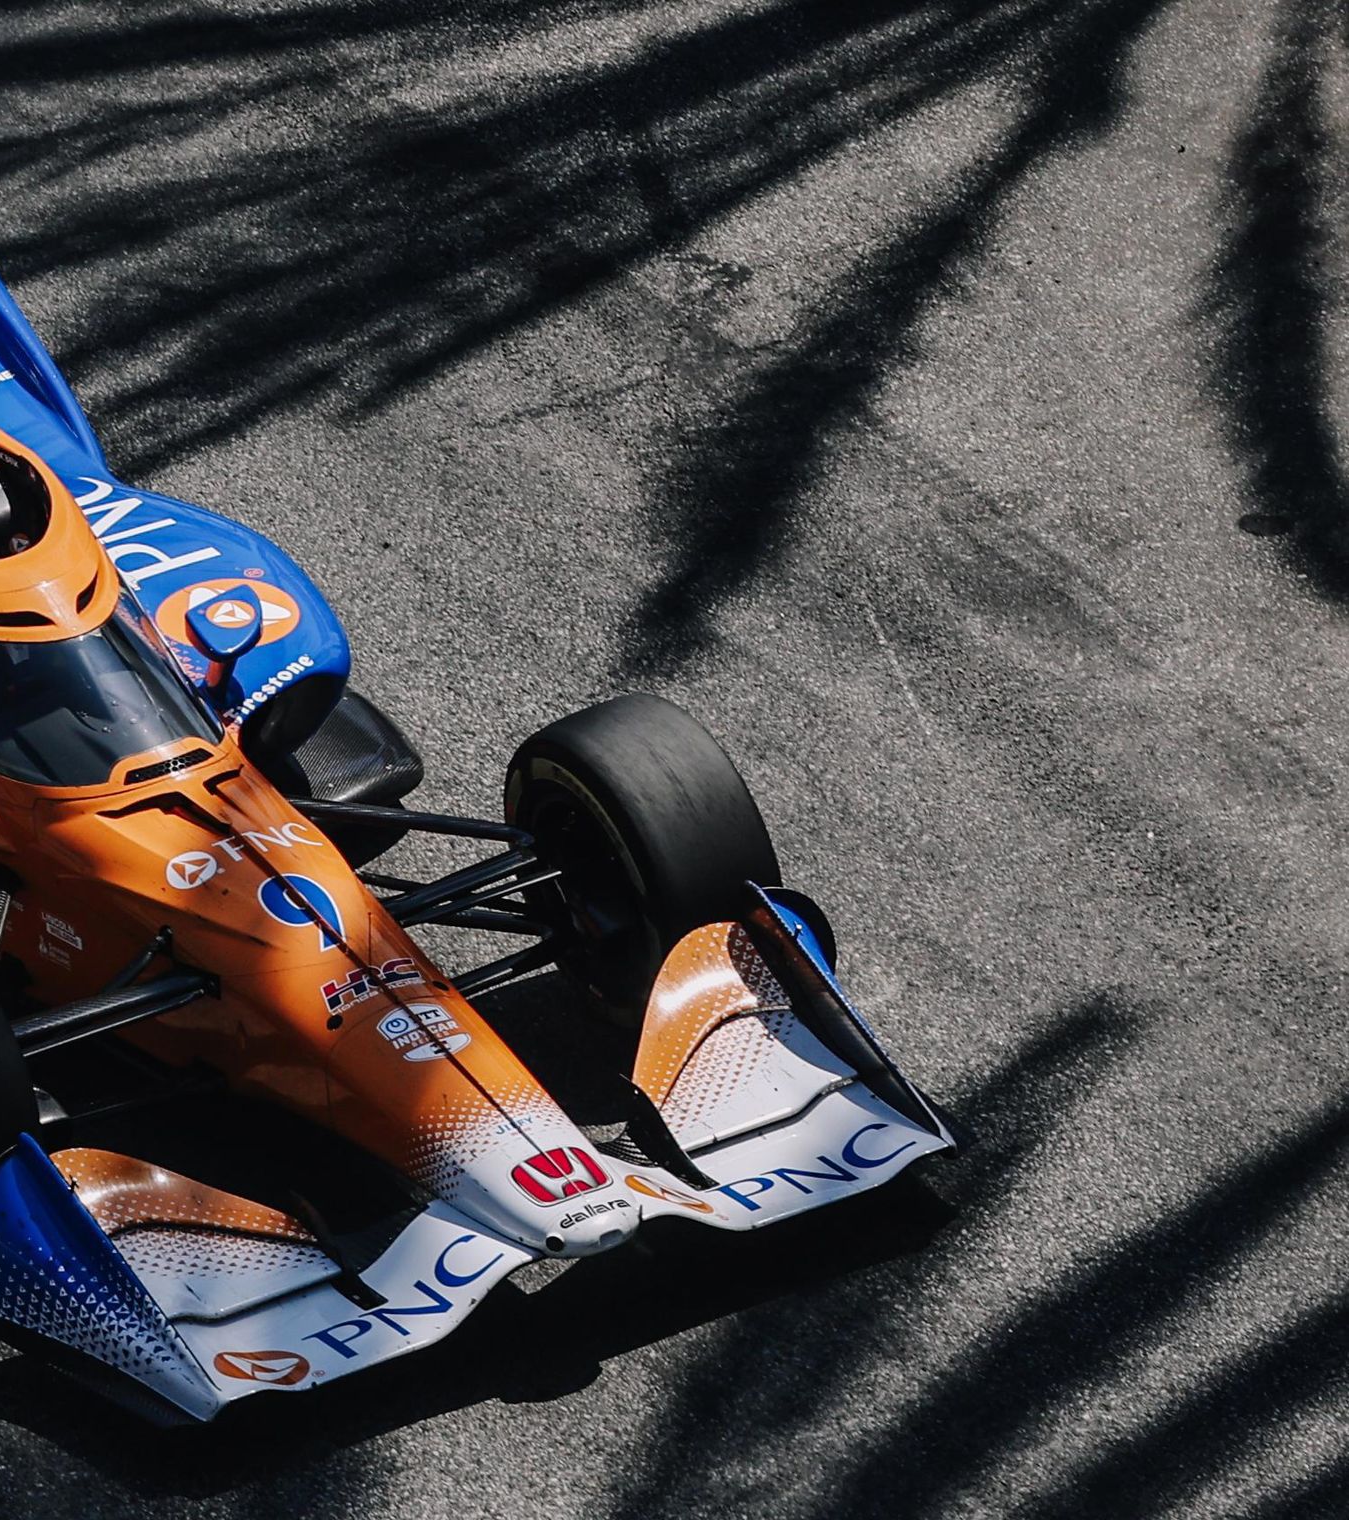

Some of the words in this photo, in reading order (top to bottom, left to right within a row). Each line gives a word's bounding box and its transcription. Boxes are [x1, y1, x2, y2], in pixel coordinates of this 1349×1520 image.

[223, 653, 315, 727] Firestone
[257, 873, 347, 953] 9
[320, 957, 420, 1014] HRC
[496, 1114, 534, 1135] JIFY
[705, 1123, 917, 1212] PNC
[559, 1199, 631, 1229] dallara
[301, 1234, 504, 1360] PNC
